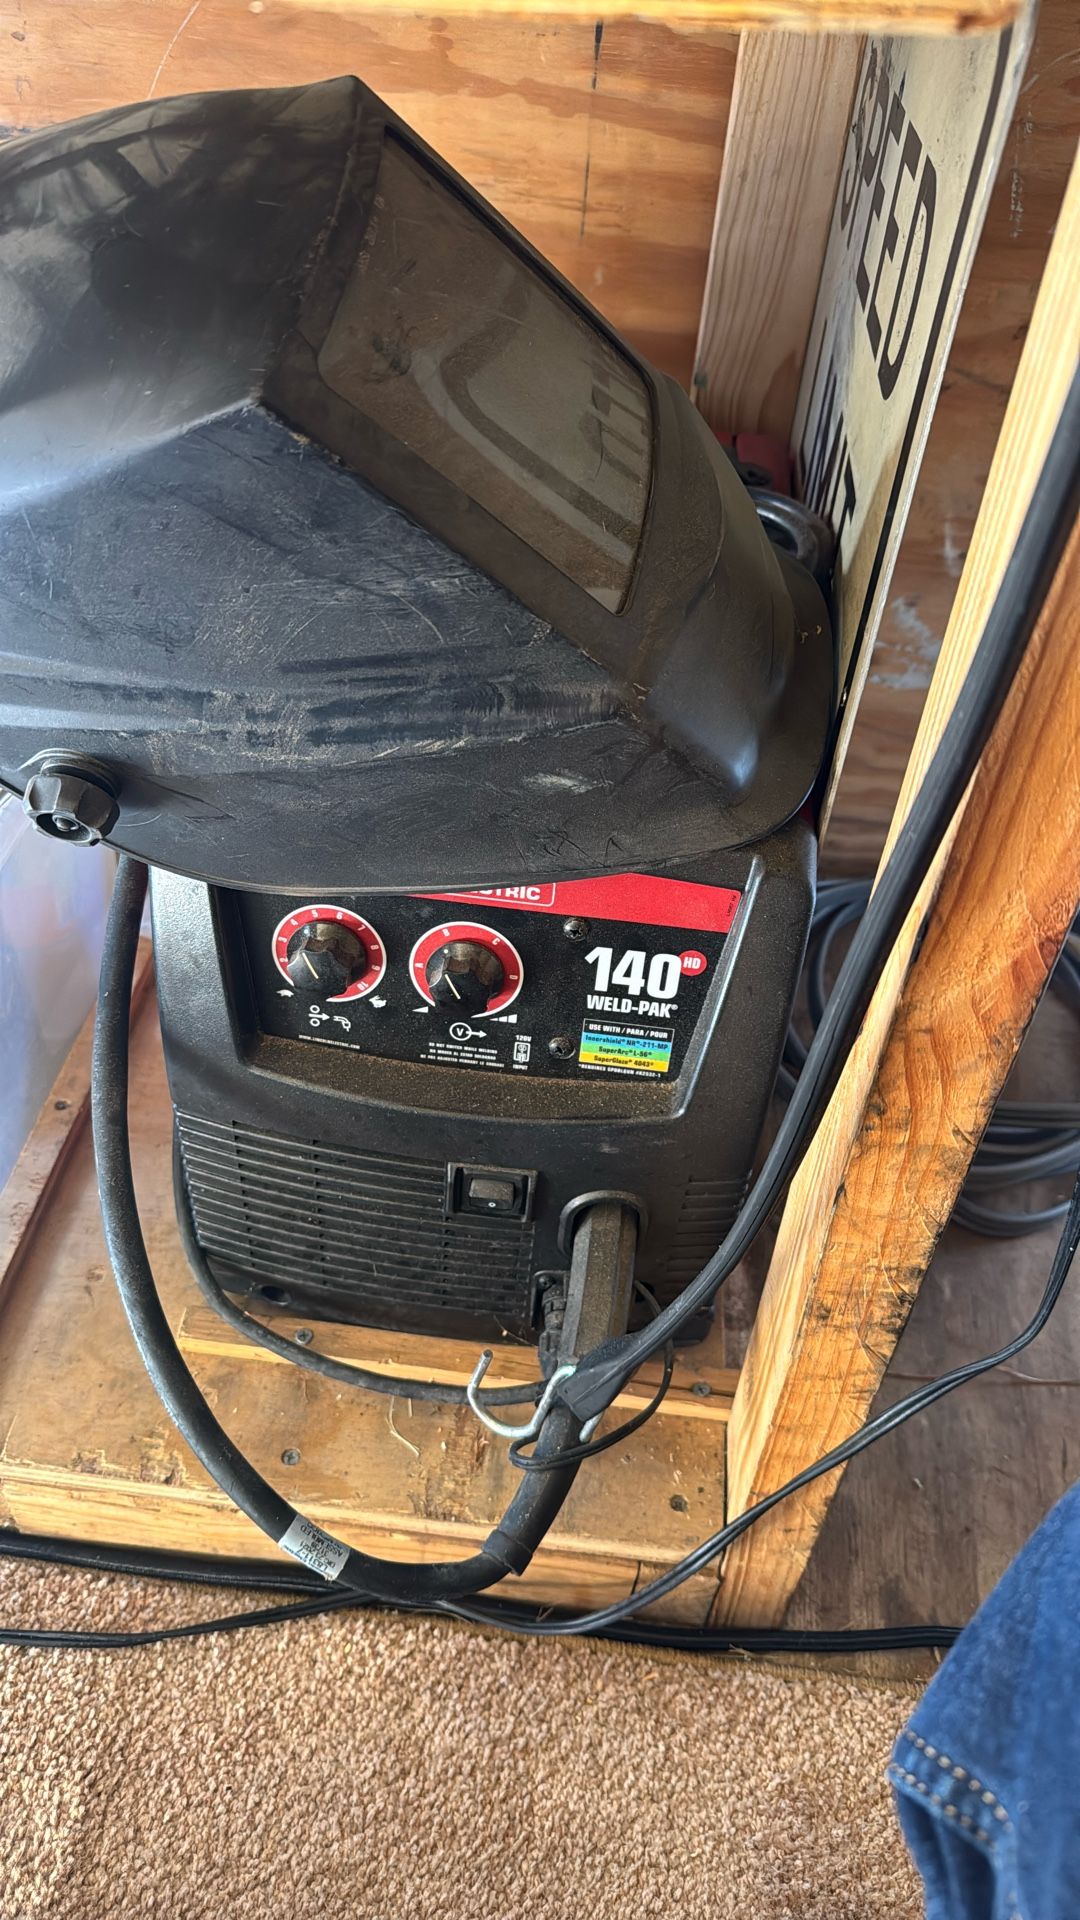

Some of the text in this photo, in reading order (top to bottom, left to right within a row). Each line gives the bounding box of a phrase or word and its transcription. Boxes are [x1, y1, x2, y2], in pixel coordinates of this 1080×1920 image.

[840, 45, 937, 400] SPEED
[311, 909, 318, 918] 5
[336, 911, 343, 920] 6
[584, 946, 701, 999] 140 HD
[589, 1023, 602, 1031] USE
[602, 1025, 621, 1034] WITH
[626, 1028, 644, 1036] PARA
[650, 1031, 668, 1039] POUR
